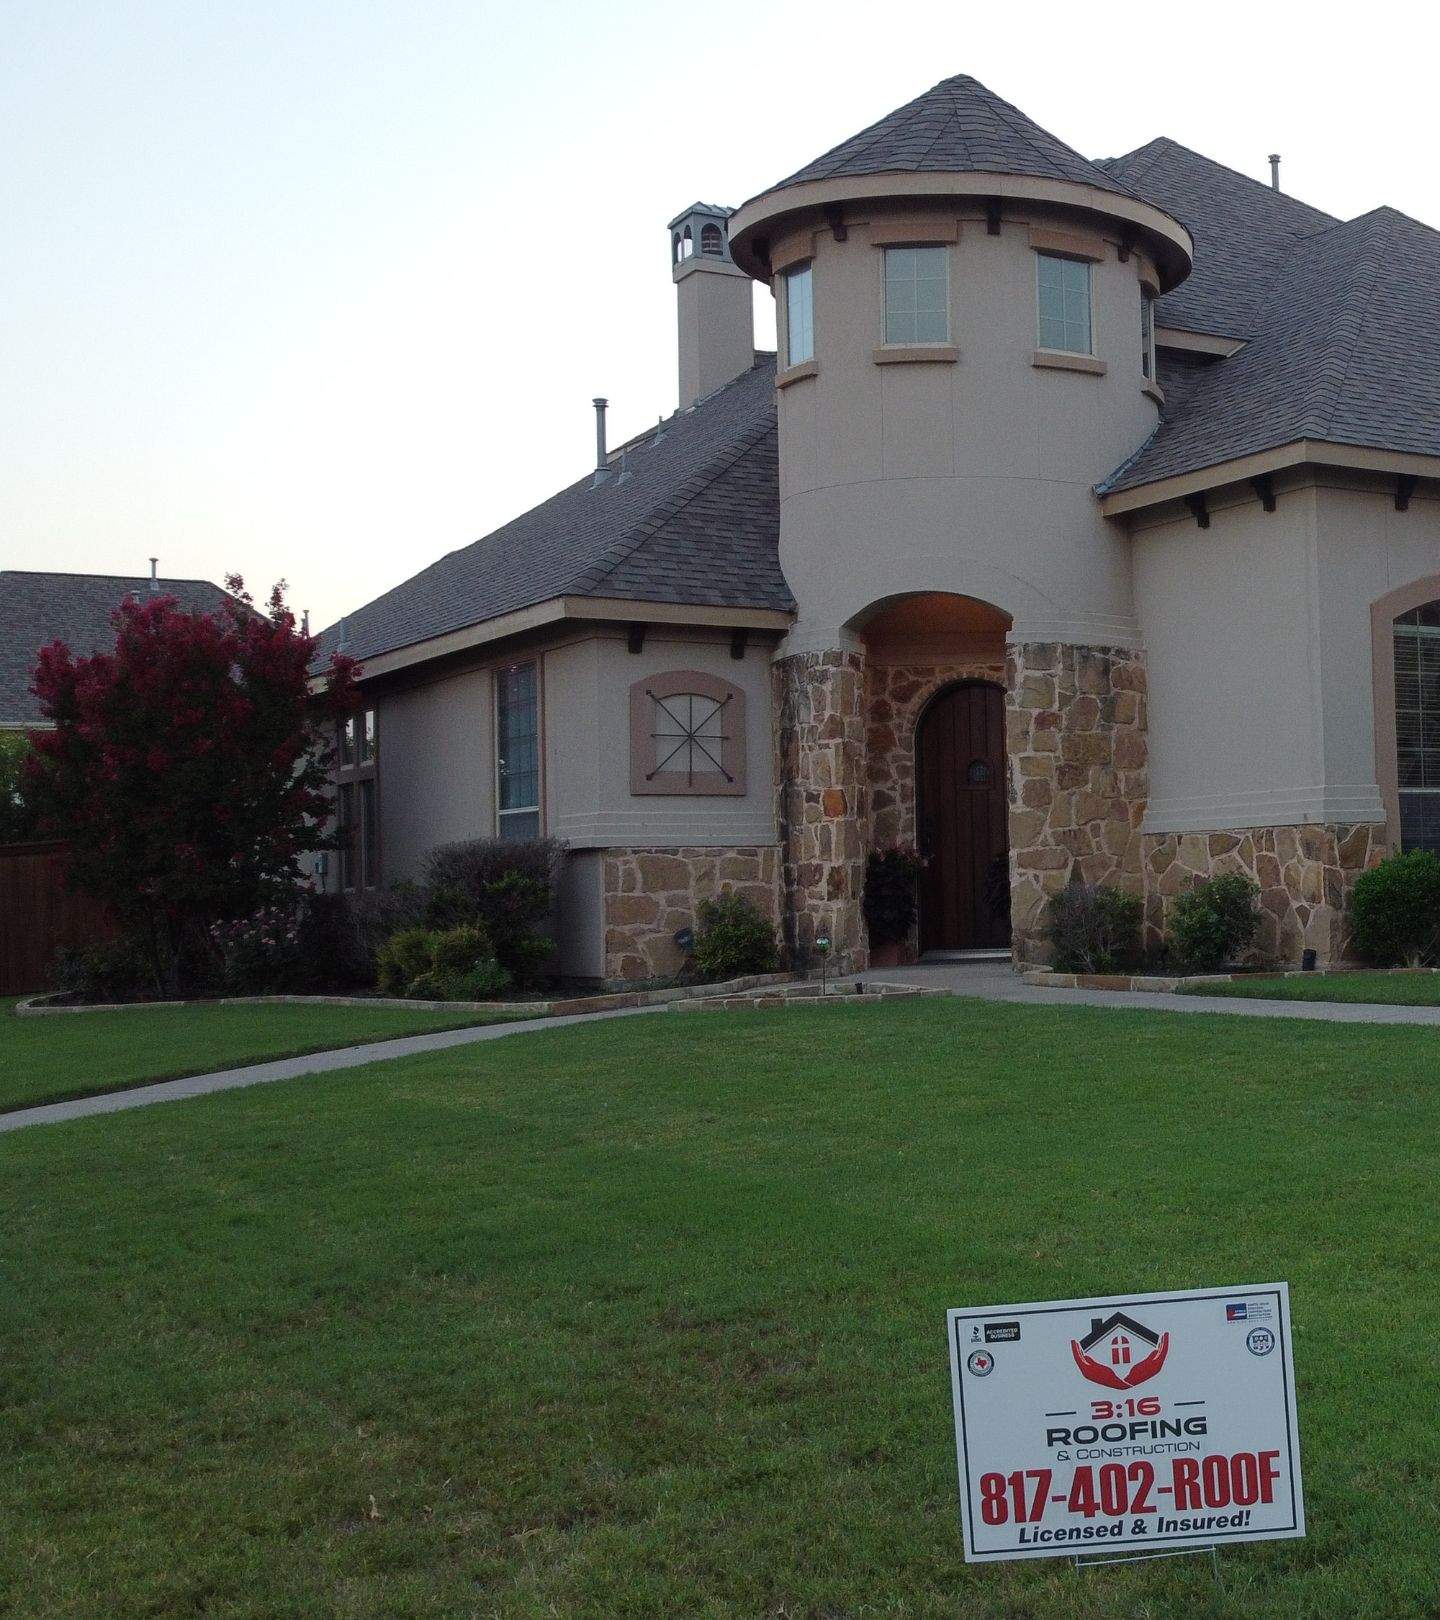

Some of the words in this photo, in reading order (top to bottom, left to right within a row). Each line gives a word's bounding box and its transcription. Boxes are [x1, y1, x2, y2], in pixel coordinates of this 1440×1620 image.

[1090, 1396, 1162, 1420] 3:16
[1046, 1416, 1208, 1447] ROOFING
[1056, 1450, 1070, 1462] &
[1076, 1440, 1201, 1461] CONSTRUCTION
[979, 1450, 1280, 1526] 817-402-ROOF
[1018, 1519, 1124, 1544] Licensed
[1130, 1518, 1148, 1535] &
[1157, 1509, 1252, 1533] Insured!
